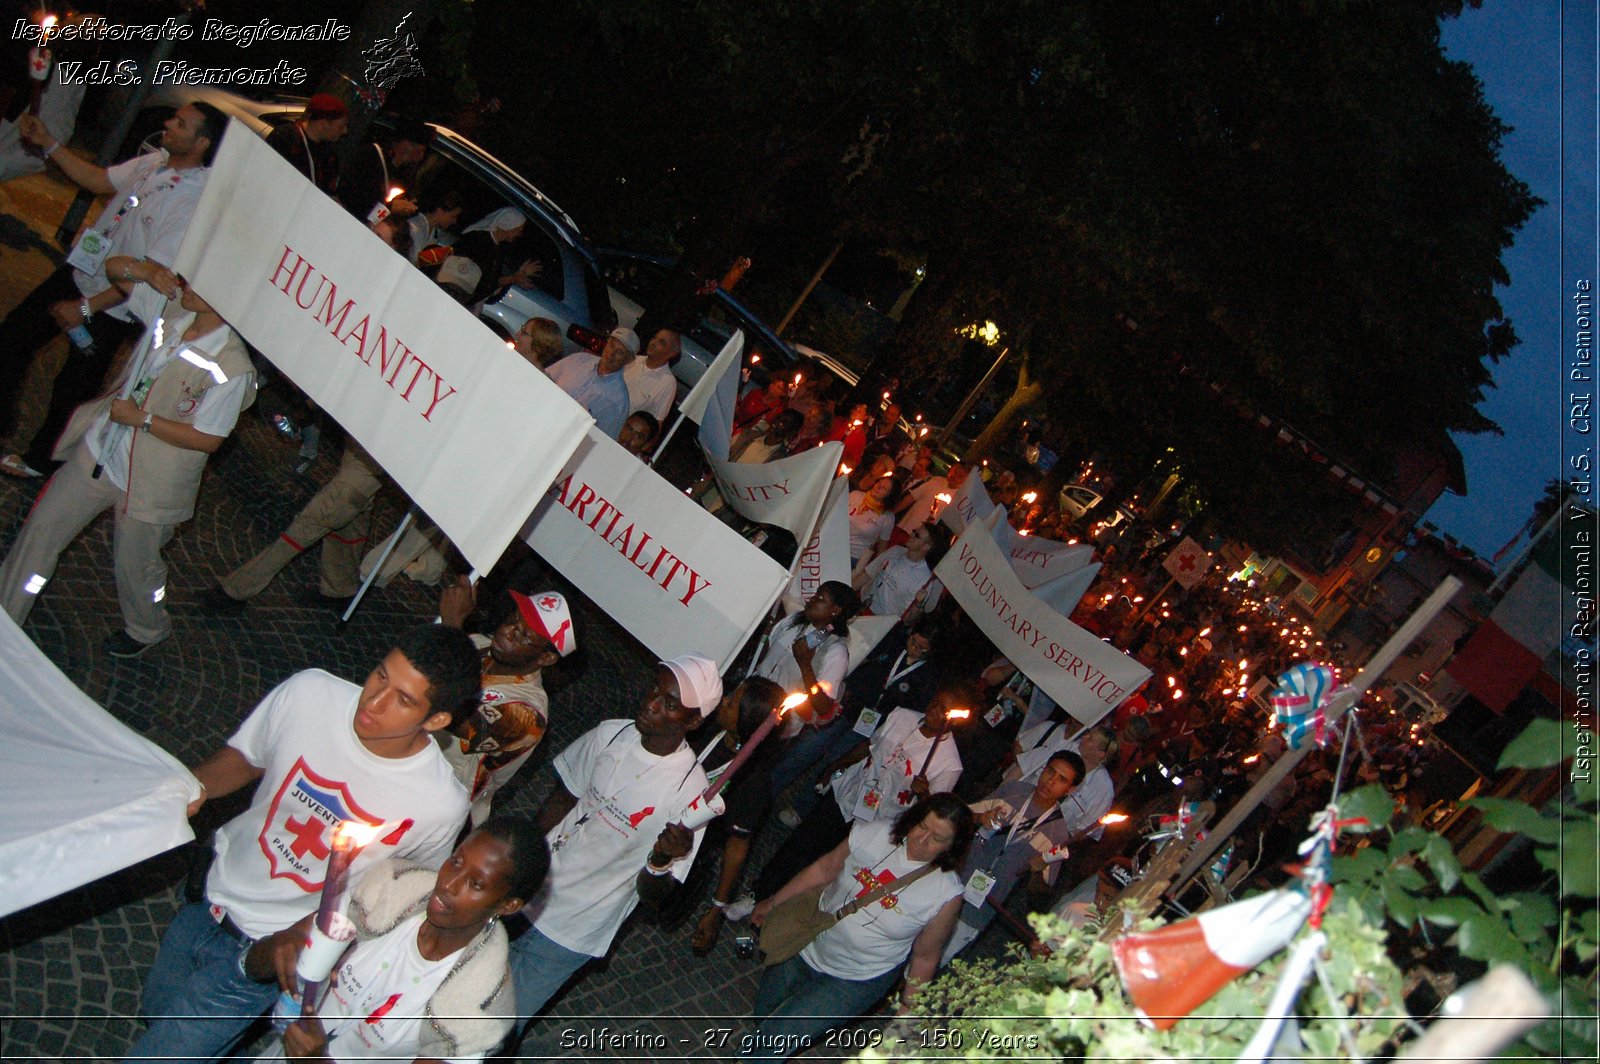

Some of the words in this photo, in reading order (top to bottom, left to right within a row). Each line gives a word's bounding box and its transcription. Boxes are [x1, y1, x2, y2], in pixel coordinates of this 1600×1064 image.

[269, 245, 457, 422] HUMANITY
[958, 496, 977, 522] UN
[958, 544, 1047, 650] VOLUNTARY
[1044, 642, 1124, 704] SERVICE
[291, 789, 342, 828] JUVENT
[272, 837, 310, 875] PANAMA
